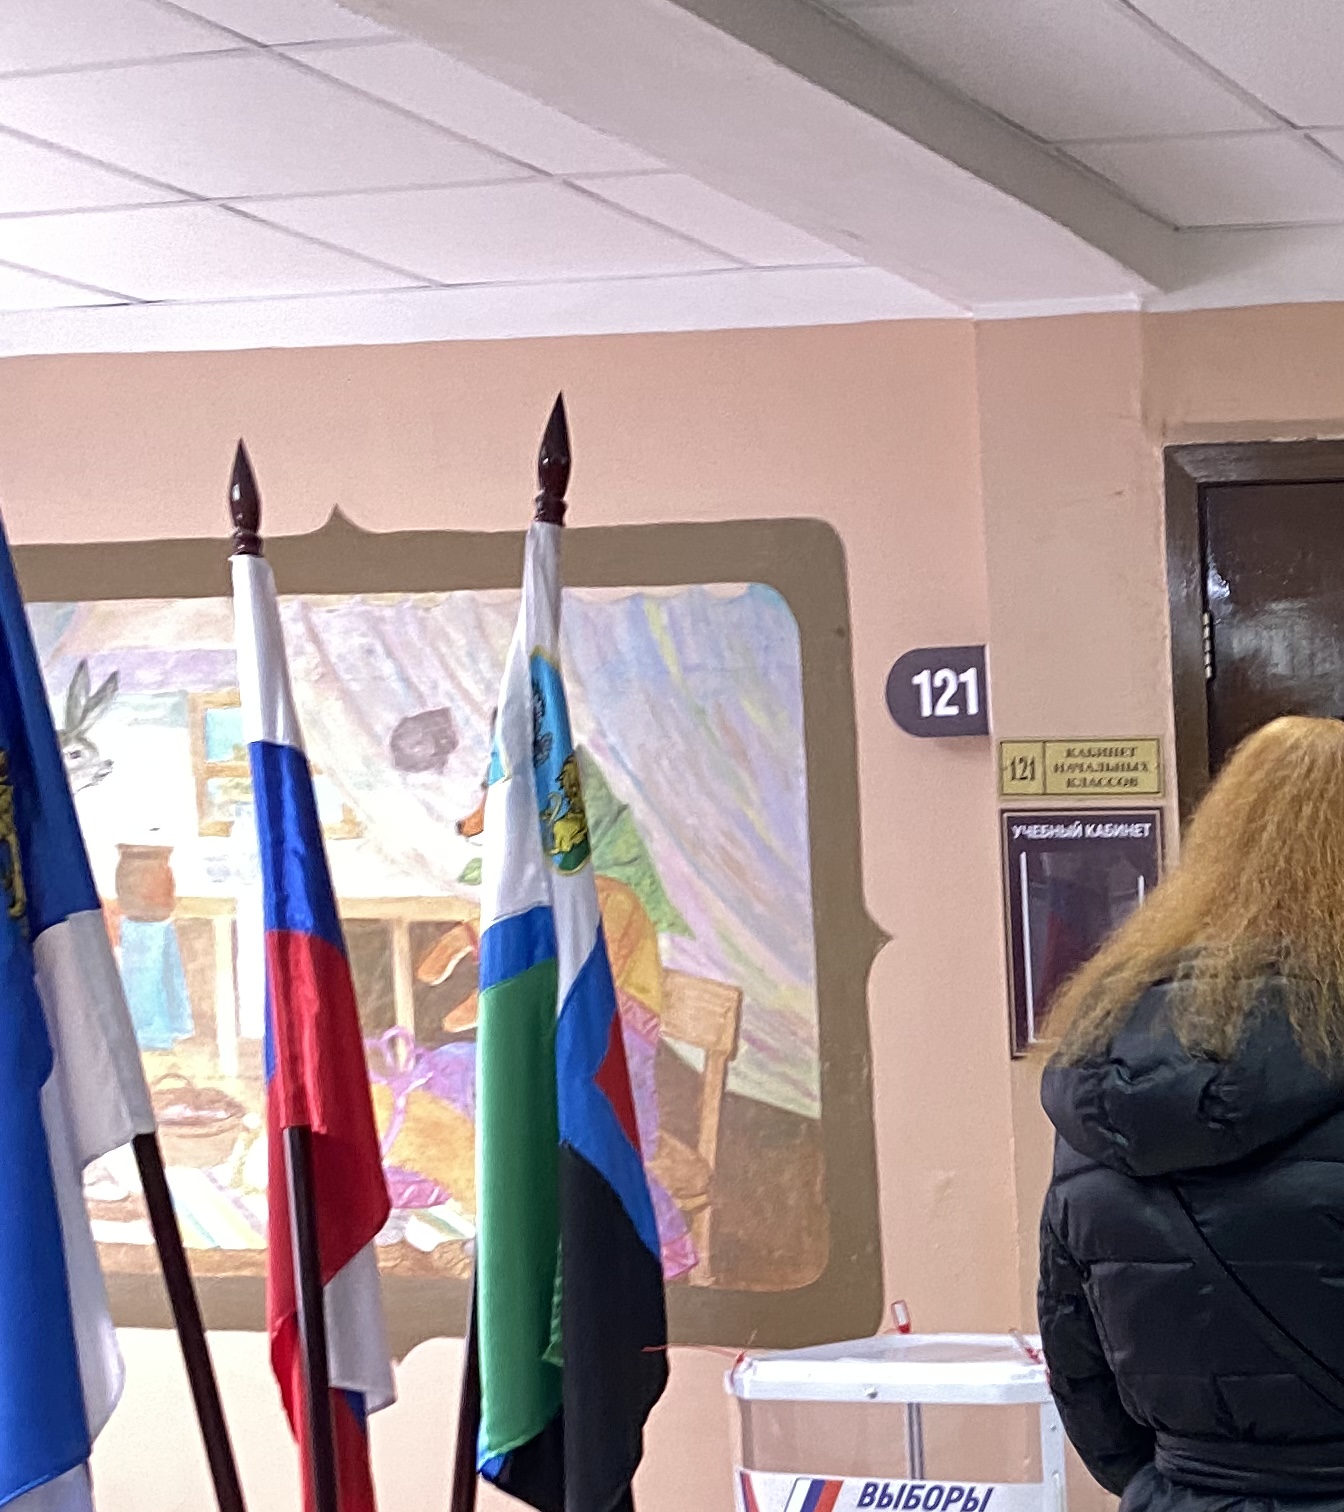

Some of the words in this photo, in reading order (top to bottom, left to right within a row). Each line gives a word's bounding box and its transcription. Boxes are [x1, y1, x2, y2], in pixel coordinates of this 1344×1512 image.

[911, 666, 980, 718] 121
[1064, 746, 1139, 758] КАБИНЕТ
[1009, 755, 1036, 782] 121
[1012, 819, 1083, 840] УЧЕБНЫЙ
[1085, 822, 1152, 838] КАБИНЕТ
